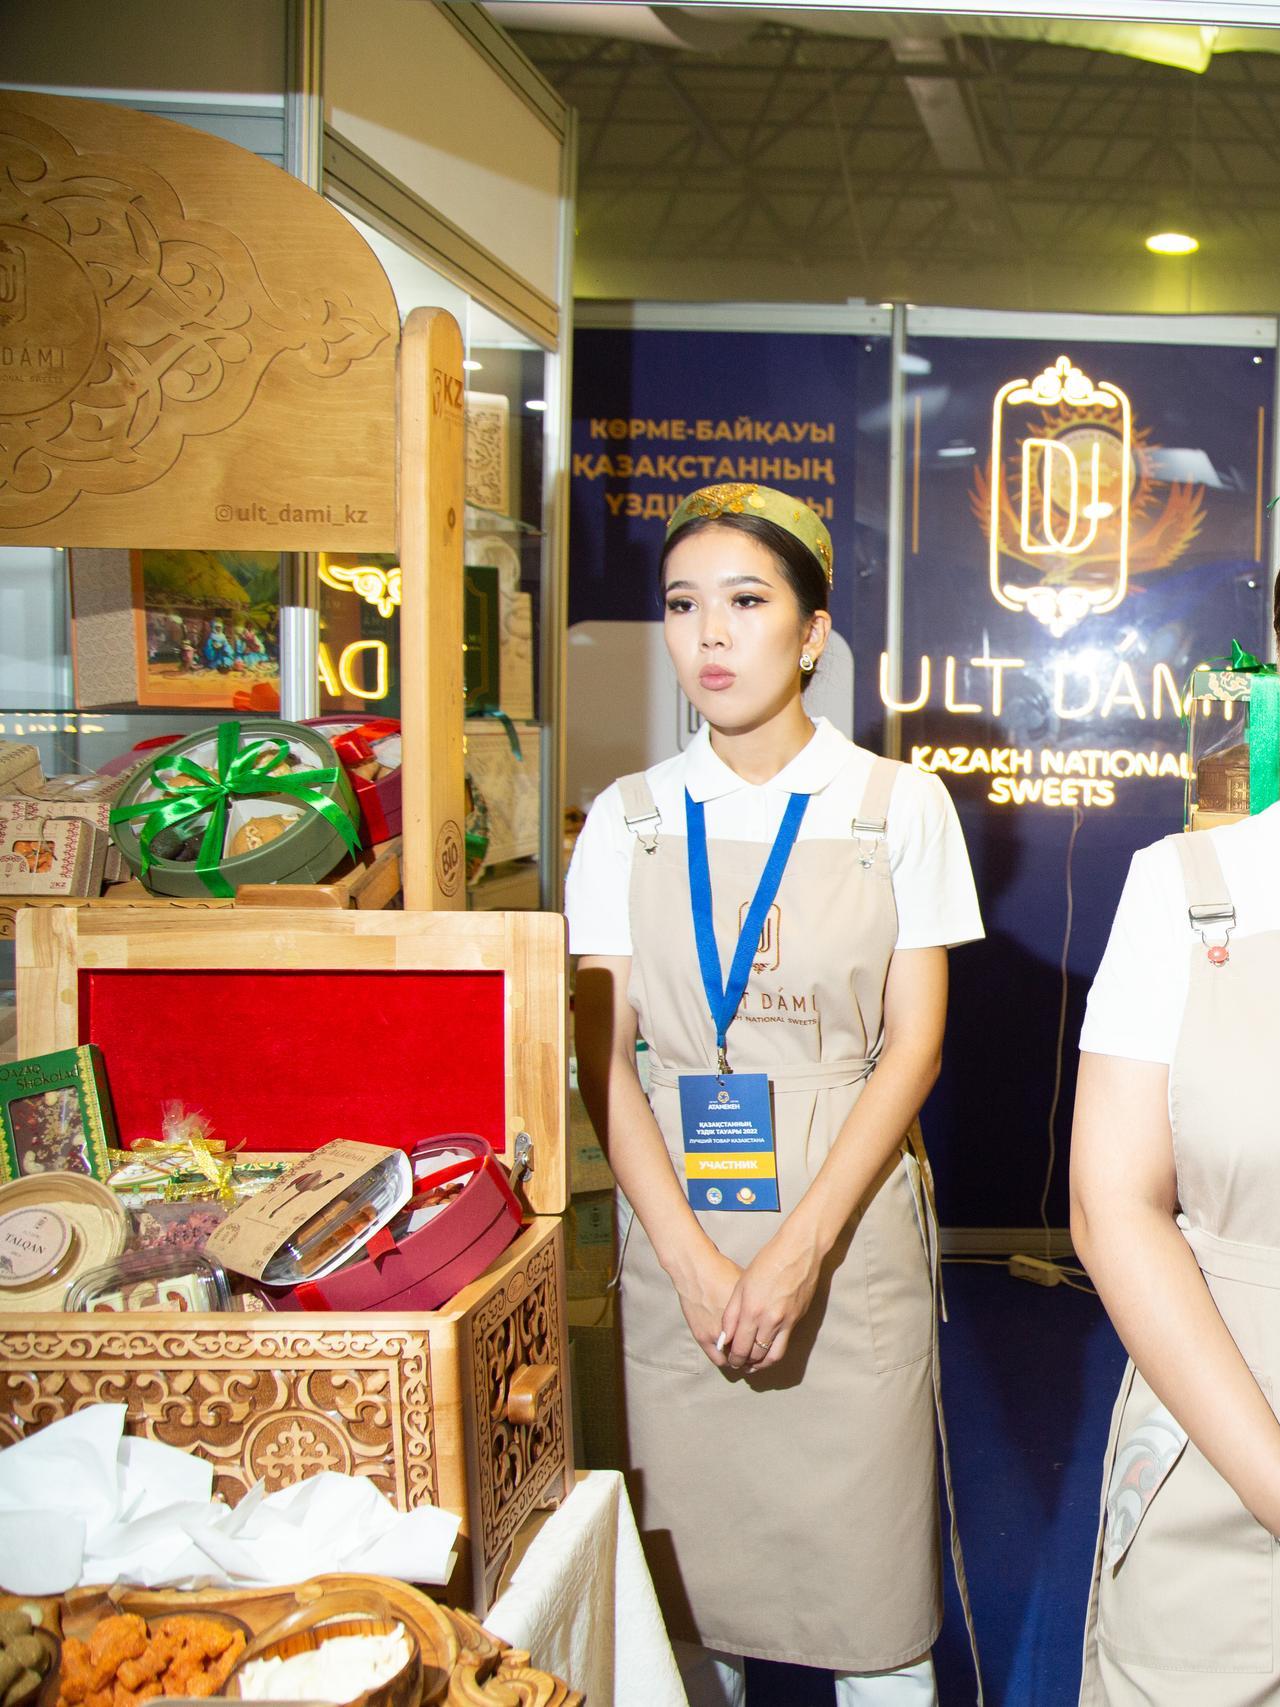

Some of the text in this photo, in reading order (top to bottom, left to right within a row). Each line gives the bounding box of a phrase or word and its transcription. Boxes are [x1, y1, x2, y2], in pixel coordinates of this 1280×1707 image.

[589, 416, 836, 445] КӨРМЕ-БАЙҚАУЫ
[572, 453, 837, 485] ҚАЗАҚСТАННЫҢ
[237, 502, 369, 526] ult_dami_kz
[605, 492, 685, 520] ҮЗДІ
[879, 651, 1026, 718] ULT
[911, 745, 1197, 780] KAZAKH NATIONAL
[988, 778, 1115, 807] SWEETS
[441, 842, 458, 876] BIO
[788, 1018, 817, 1026] SWEETS
[699, 1160, 758, 1170] УЧАСТНИК
